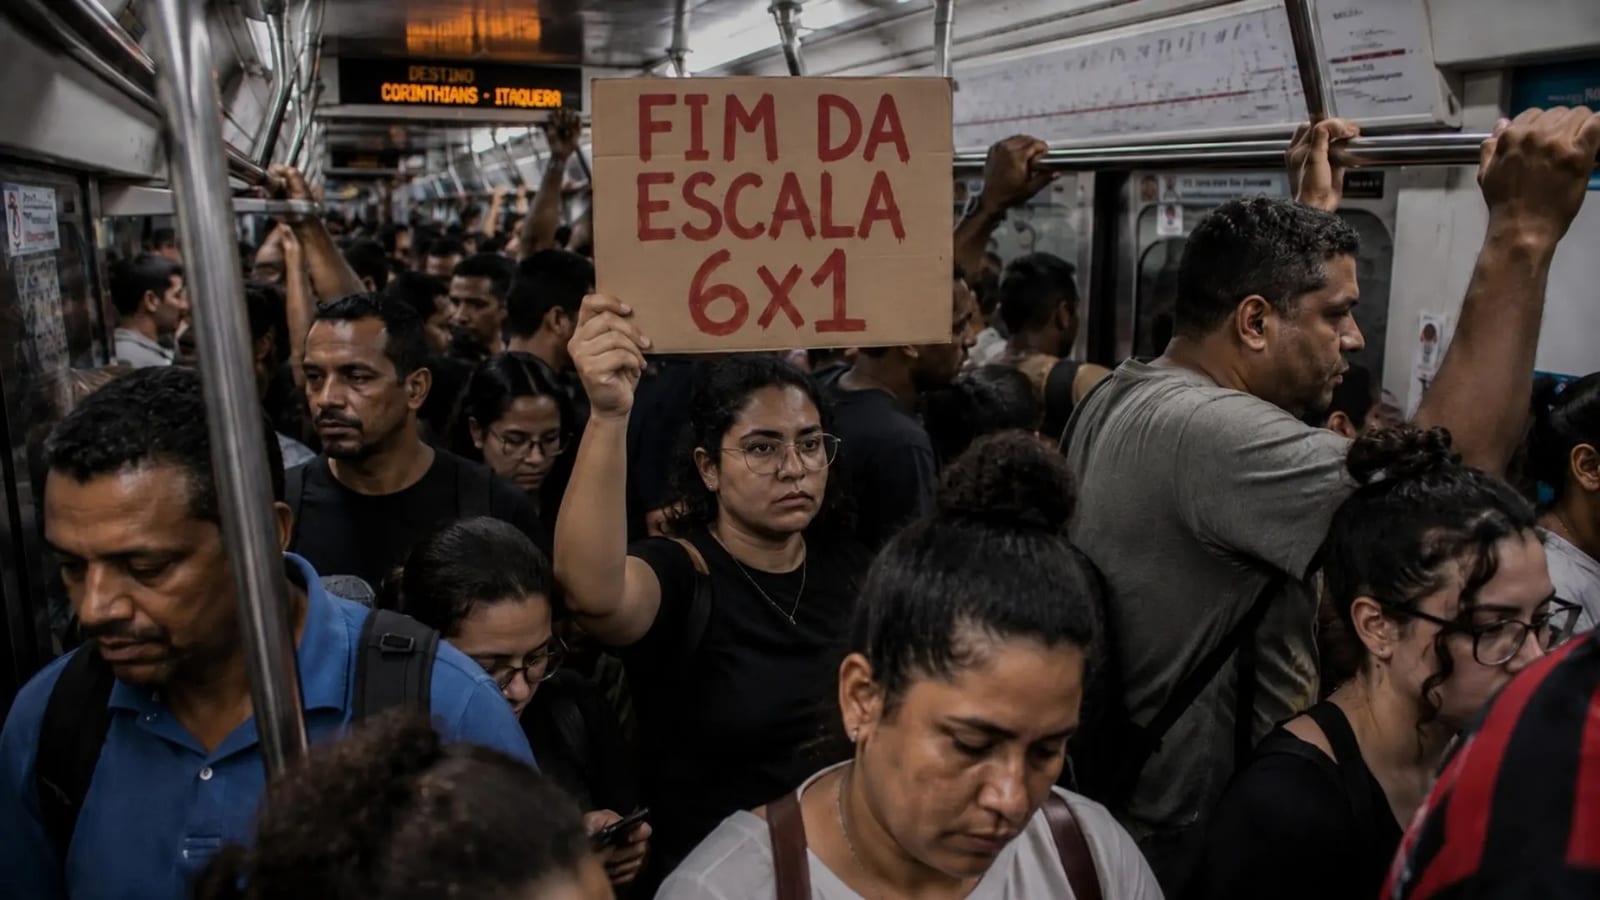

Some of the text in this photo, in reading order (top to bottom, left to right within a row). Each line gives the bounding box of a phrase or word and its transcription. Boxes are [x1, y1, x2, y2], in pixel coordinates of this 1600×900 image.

[381, 82, 563, 107] CORINTHIANS ITAQUERA
[408, 65, 475, 82] DESTINO
[639, 94, 910, 163] FIM DA
[637, 171, 906, 243] ESCALA
